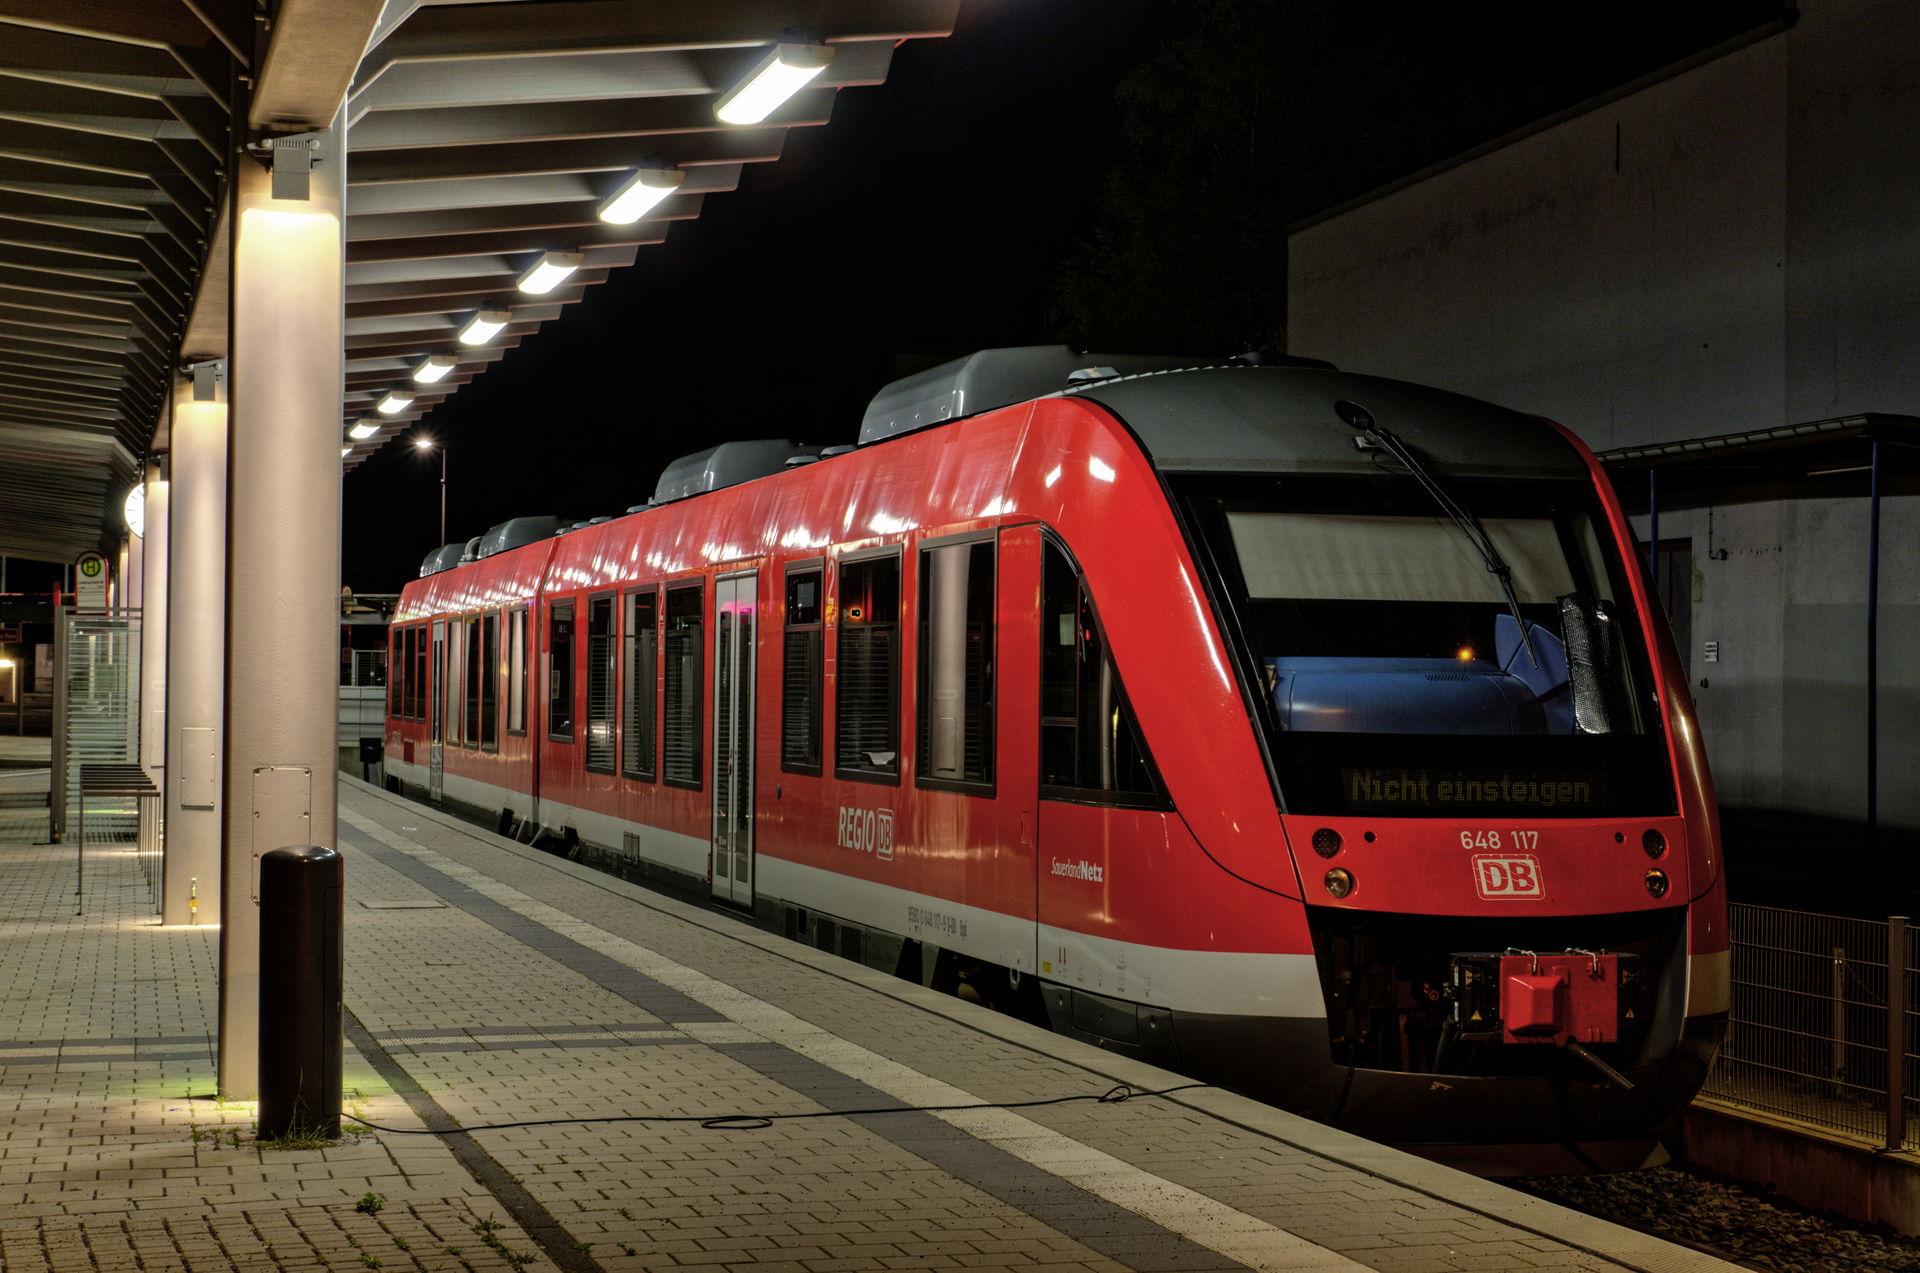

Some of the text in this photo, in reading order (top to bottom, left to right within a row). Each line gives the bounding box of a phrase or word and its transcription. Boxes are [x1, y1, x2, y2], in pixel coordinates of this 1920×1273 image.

[828, 559, 835, 605] 2
[1352, 771, 1590, 806] Nicht einsteigen
[838, 806, 892, 854] REGIO DB
[1460, 830, 1539, 850] 648 117
[1051, 856, 1104, 882] SauerlandNetz
[1479, 859, 1539, 895] DB
